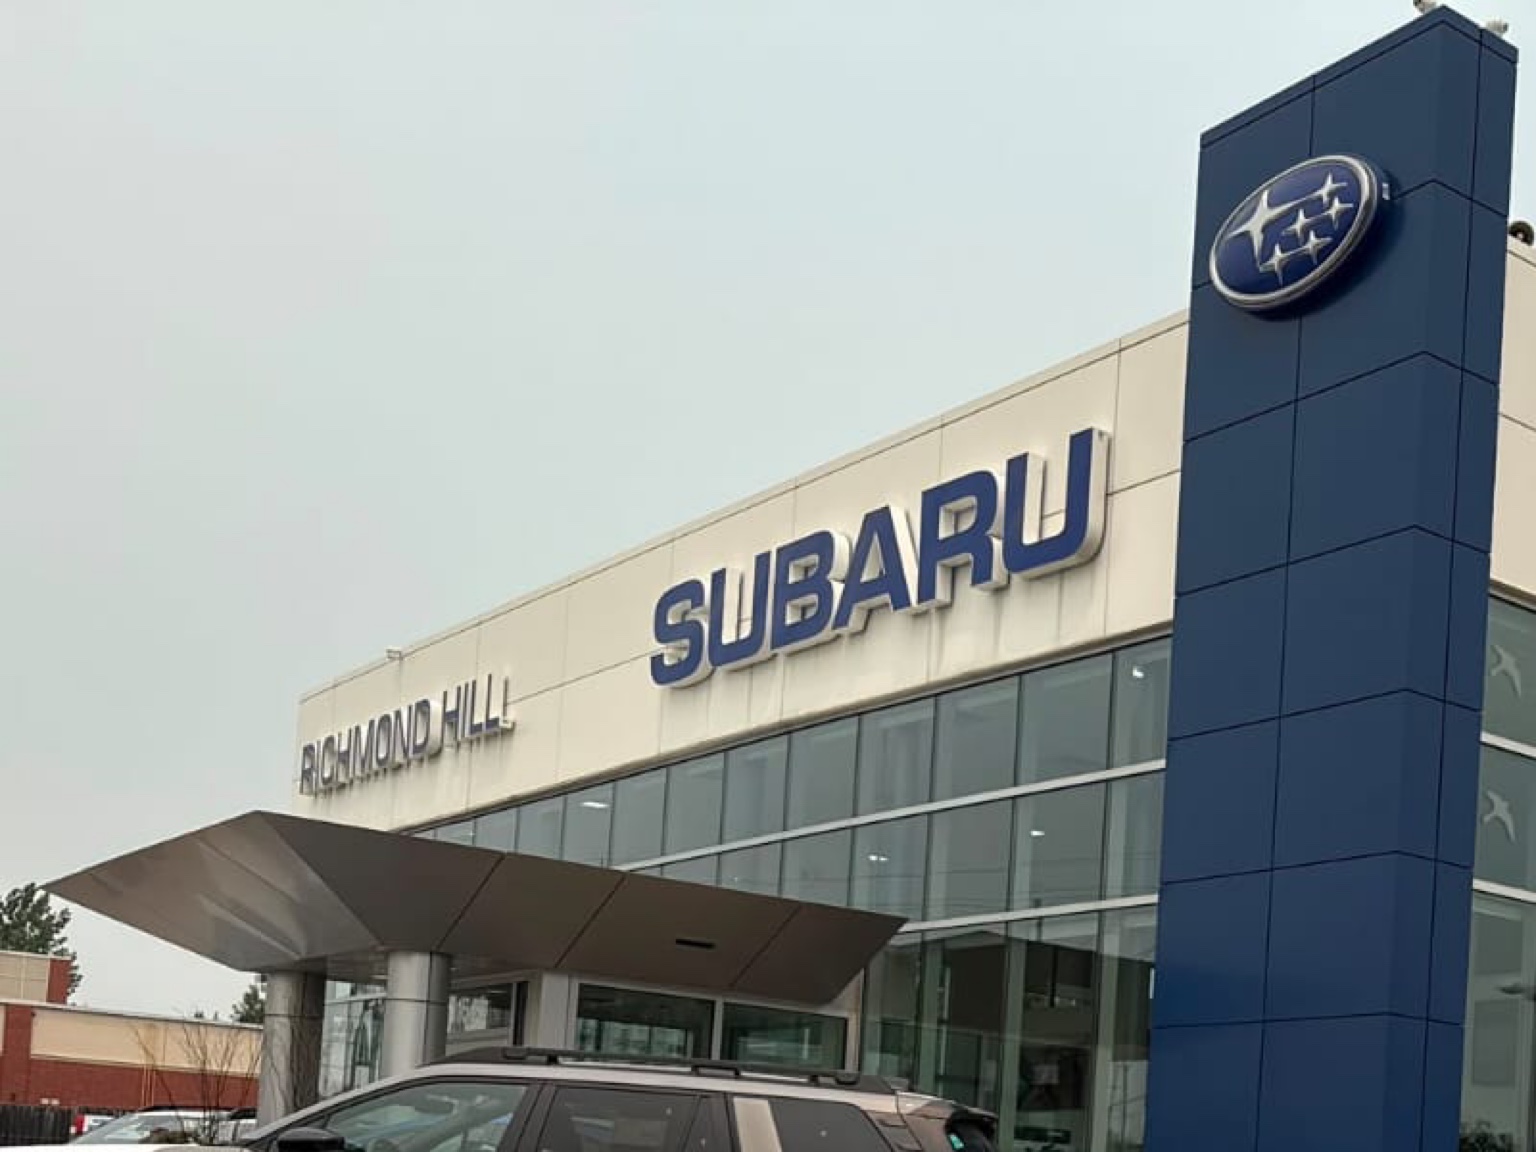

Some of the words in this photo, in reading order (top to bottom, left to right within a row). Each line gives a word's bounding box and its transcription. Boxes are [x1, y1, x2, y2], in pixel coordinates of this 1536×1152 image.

[650, 427, 1100, 688] SUBARU
[300, 698, 436, 796] RICHMOND
[442, 673, 507, 749] HILL
